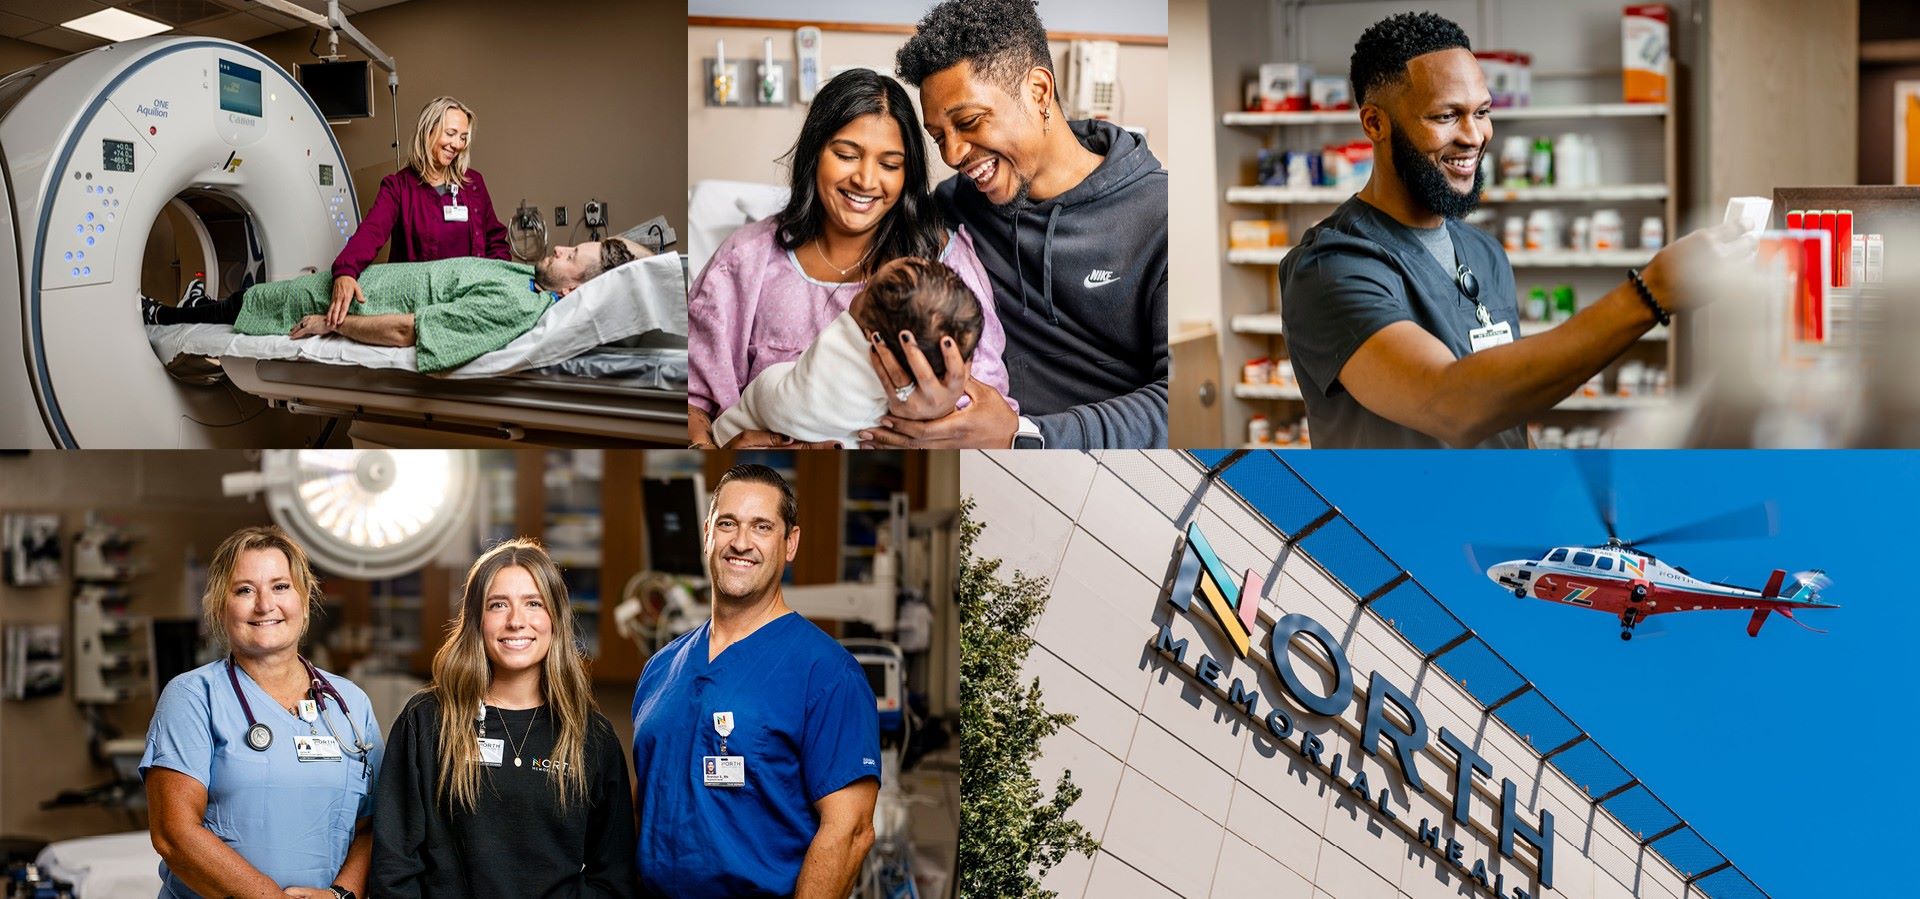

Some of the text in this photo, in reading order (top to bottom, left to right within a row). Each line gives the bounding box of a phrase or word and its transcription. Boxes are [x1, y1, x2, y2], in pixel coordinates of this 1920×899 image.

[136, 104, 168, 118] Aquilion
[154, 99, 169, 110] ONE
[228, 113, 256, 127] Canon
[1090, 269, 1113, 281] NIKE
[1168, 521, 1555, 890] NORTH
[1155, 624, 1398, 821] MEMORIAL
